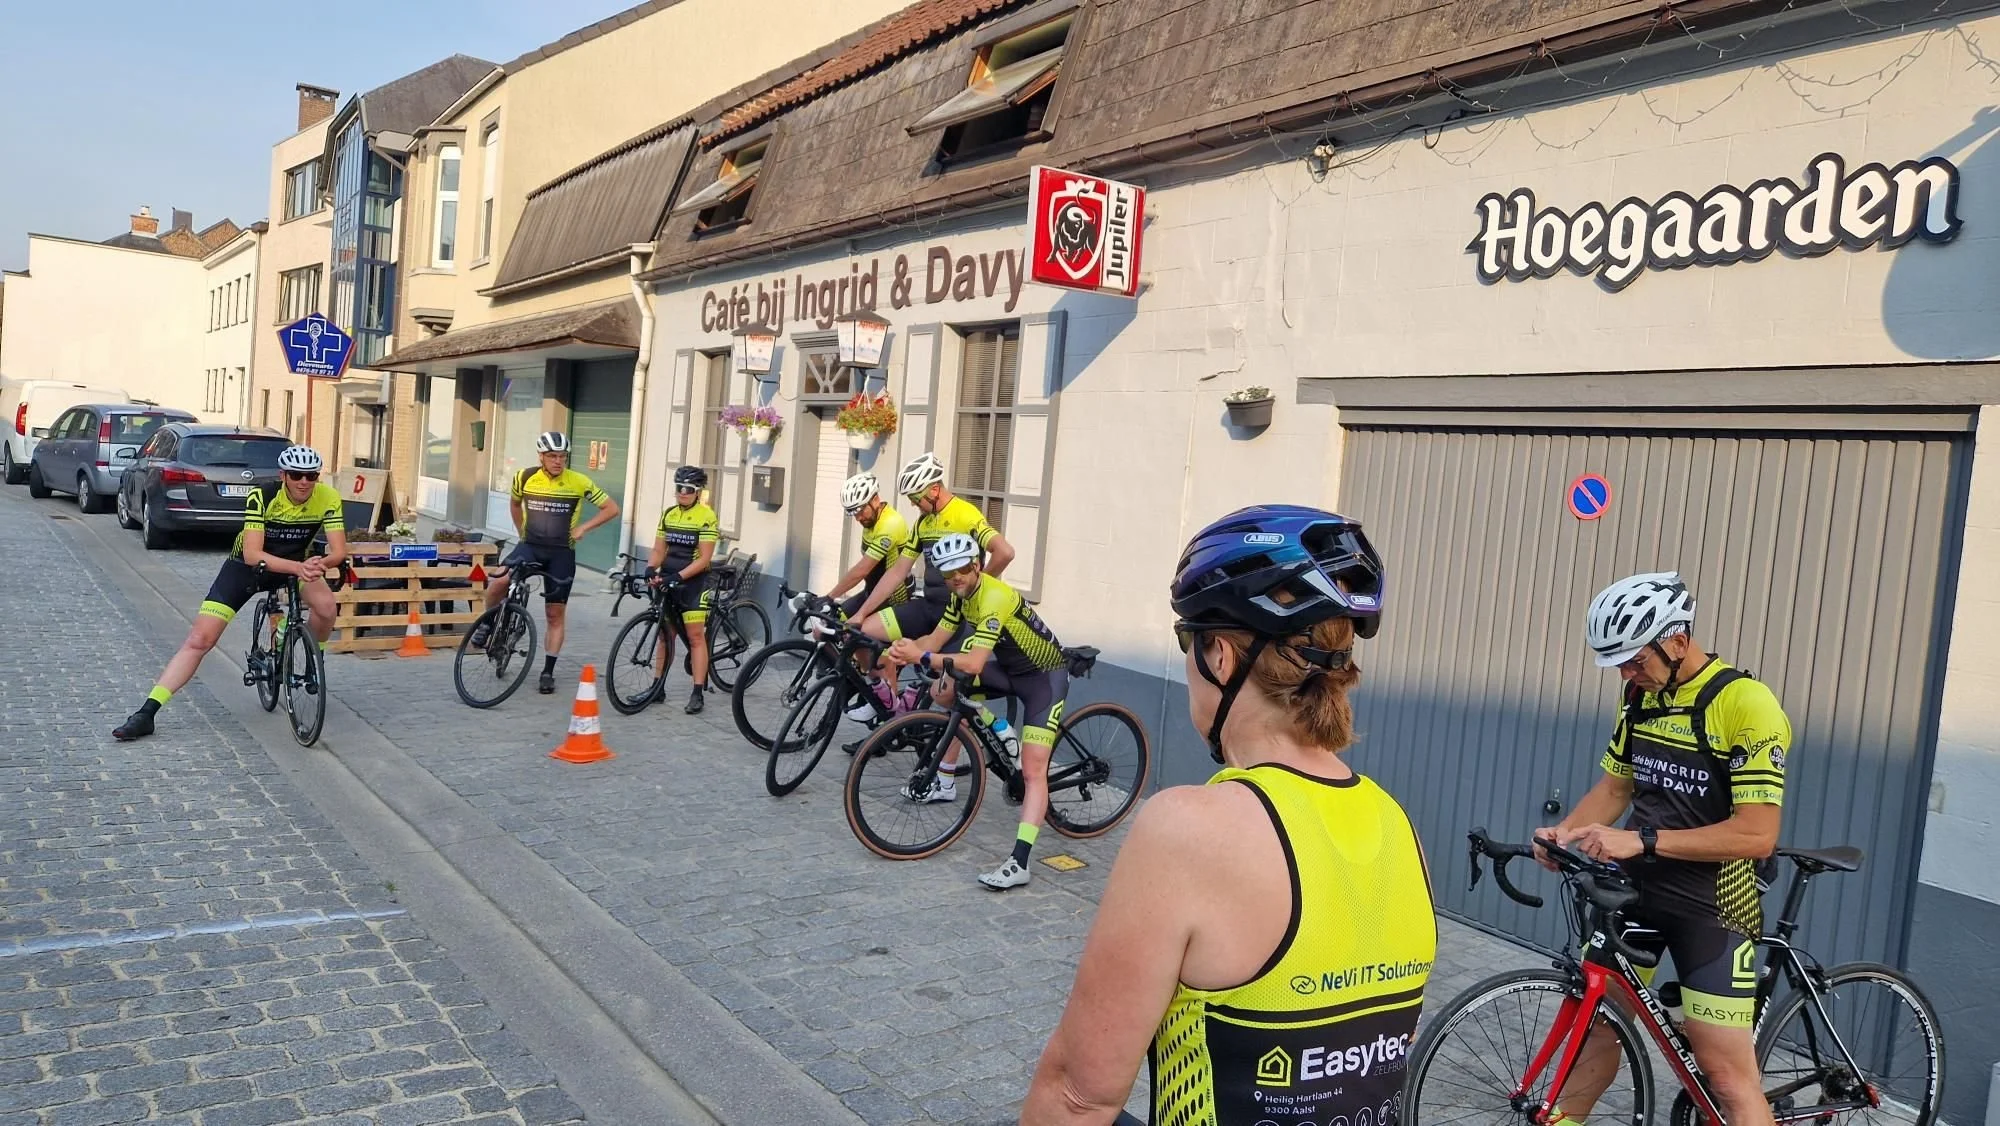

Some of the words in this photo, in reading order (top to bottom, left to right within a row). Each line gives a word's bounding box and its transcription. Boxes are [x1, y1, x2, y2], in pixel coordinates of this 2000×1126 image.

[1107, 188, 1128, 286] Jupiler
[1470, 153, 1960, 289] Hoegaarden
[701, 283, 750, 333] Café
[756, 278, 786, 337] bij
[794, 258, 879, 329] Ingrid
[890, 253, 912, 309] &
[925, 245, 1026, 313] Davy
[1248, 534, 1280, 542] ABUS
[973, 715, 1016, 776] ORBEA
[1654, 760, 1710, 781] INGRID
[1662, 777, 1709, 797] DAVY
[1320, 970, 1357, 993] NeVi
[1360, 965, 1375, 985] IT
[1377, 959, 1432, 982] Solutions
[1300, 1033, 1408, 1081] Easytec
[1265, 1095, 1294, 1104] Heilig
[1296, 1090, 1332, 1103] Hartlaan
[1333, 1087, 1343, 1096] 44
[1265, 1106, 1290, 1114] 9300
[1292, 1106, 1316, 1115] Aalst
